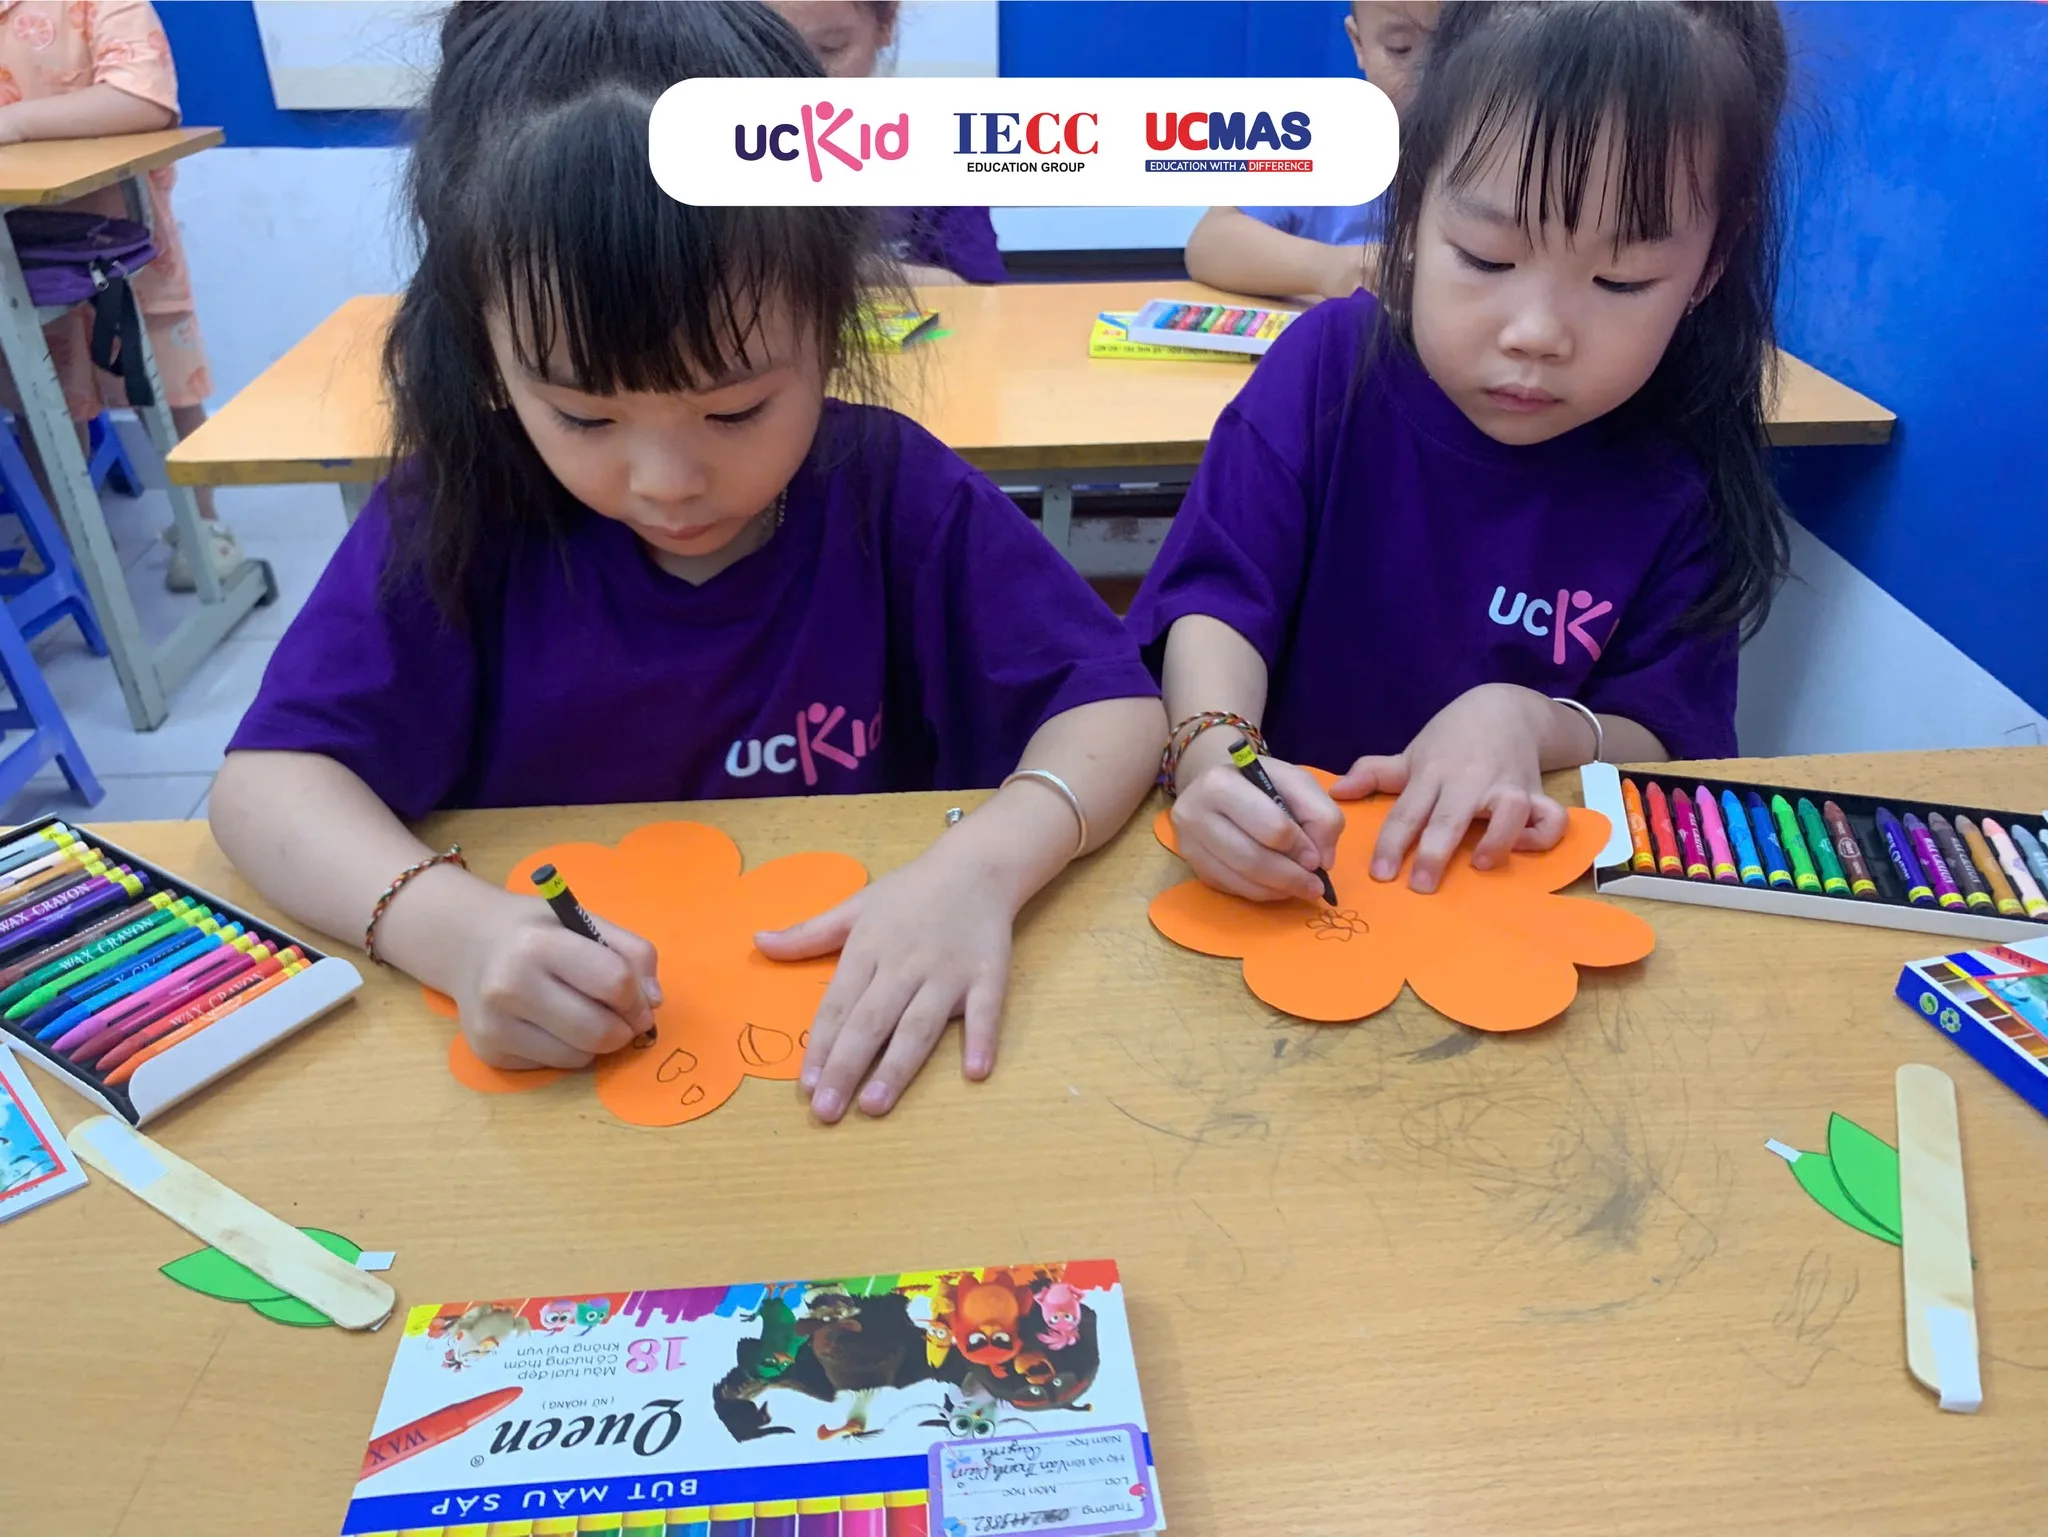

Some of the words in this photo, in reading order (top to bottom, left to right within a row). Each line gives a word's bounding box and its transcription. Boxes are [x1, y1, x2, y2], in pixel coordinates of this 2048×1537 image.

[1488, 585, 1620, 665] UCK
[0, 911, 29, 933] WAX
[31, 882, 91, 916] CRAYON
[59, 951, 91, 970] WAX
[98, 916, 154, 952] CRAYON
[169, 1005, 205, 1028] WAX
[208, 970, 266, 1009] CRAYON
[546, 1344, 570, 1355] bụi
[572, 1341, 620, 1352] Không
[625, 1336, 689, 1374] 18
[370, 1427, 429, 1467] WAX
[489, 1398, 684, 1458] Queen
[430, 1493, 502, 1518] SÁP
[521, 1484, 609, 1510] MÀU
[626, 1479, 698, 1502] BÚT
